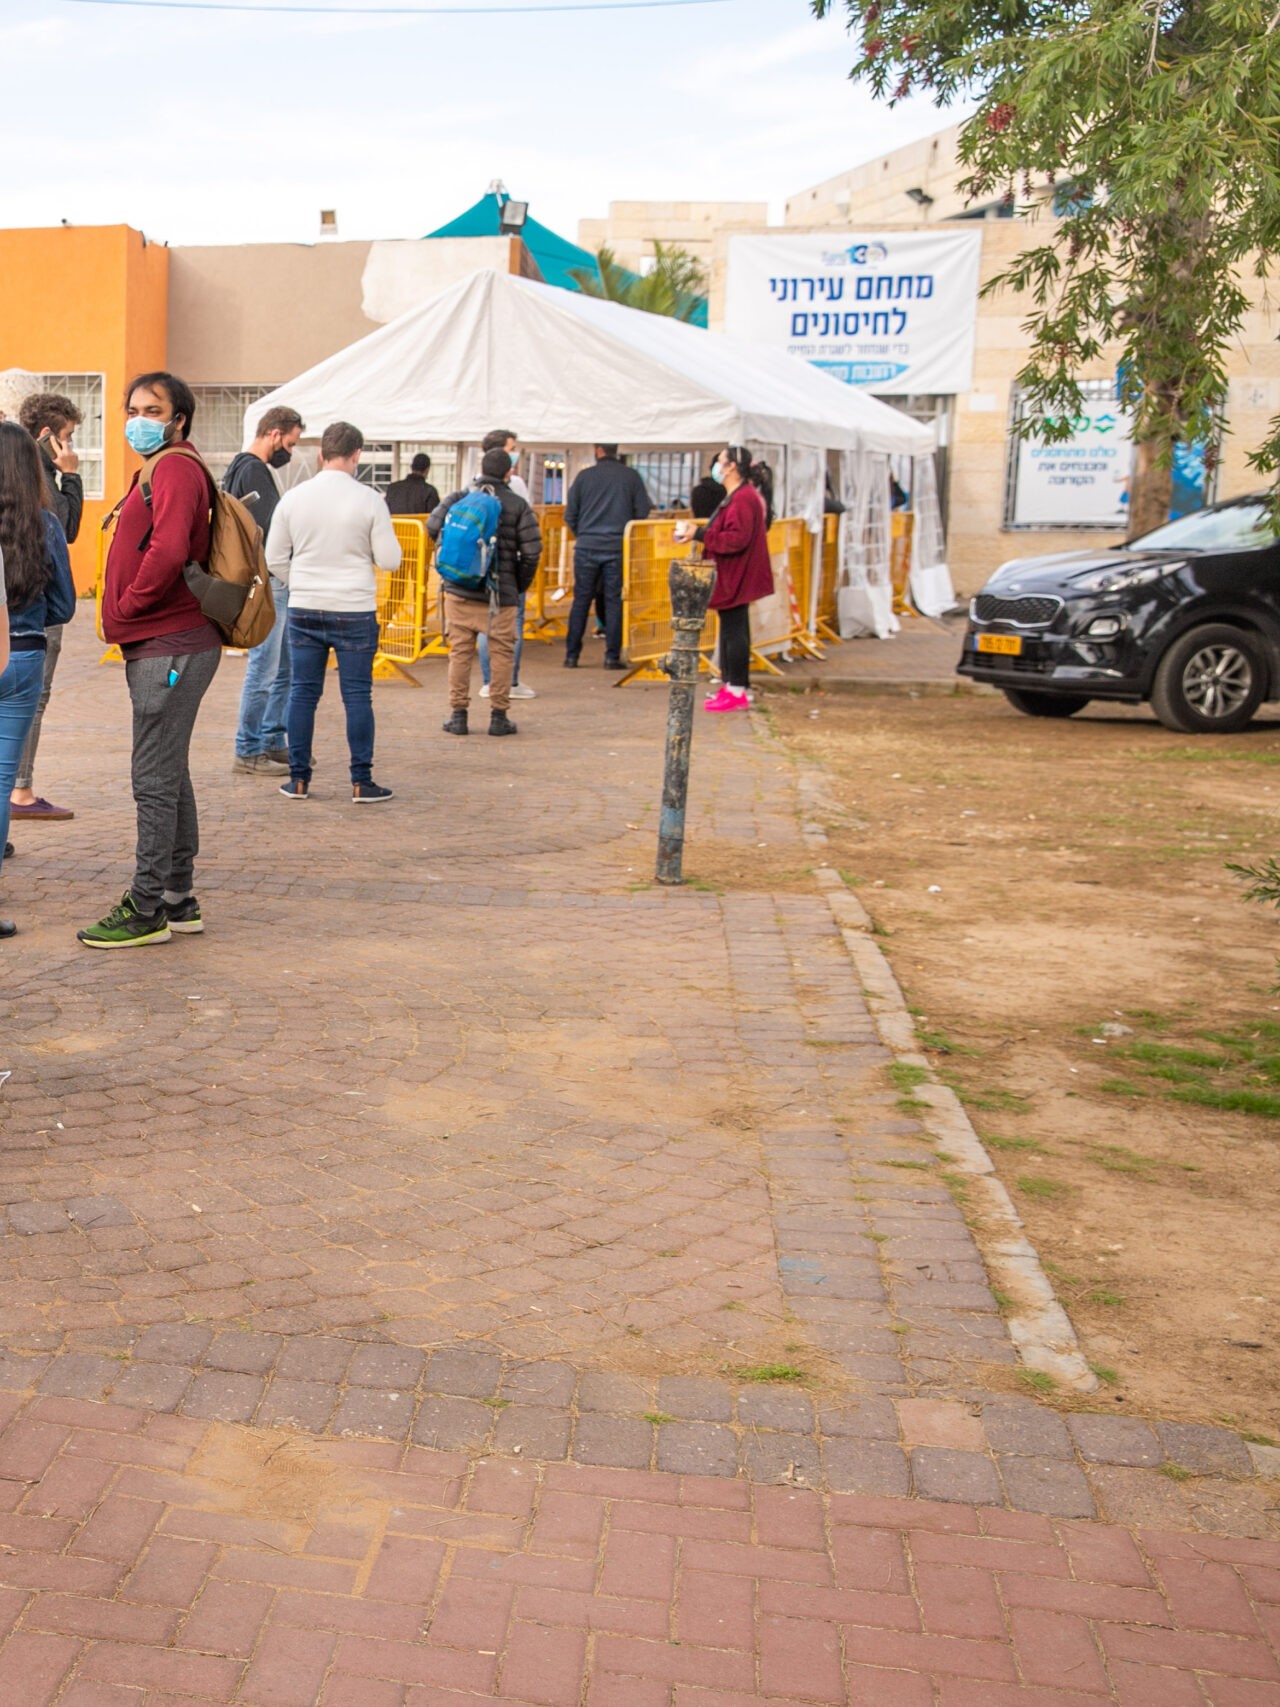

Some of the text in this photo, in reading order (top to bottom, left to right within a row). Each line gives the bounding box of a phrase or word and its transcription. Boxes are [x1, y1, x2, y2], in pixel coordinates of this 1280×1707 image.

[769, 275, 933, 302] מתחם עירוני
[790, 307, 907, 337] לחיסונים
